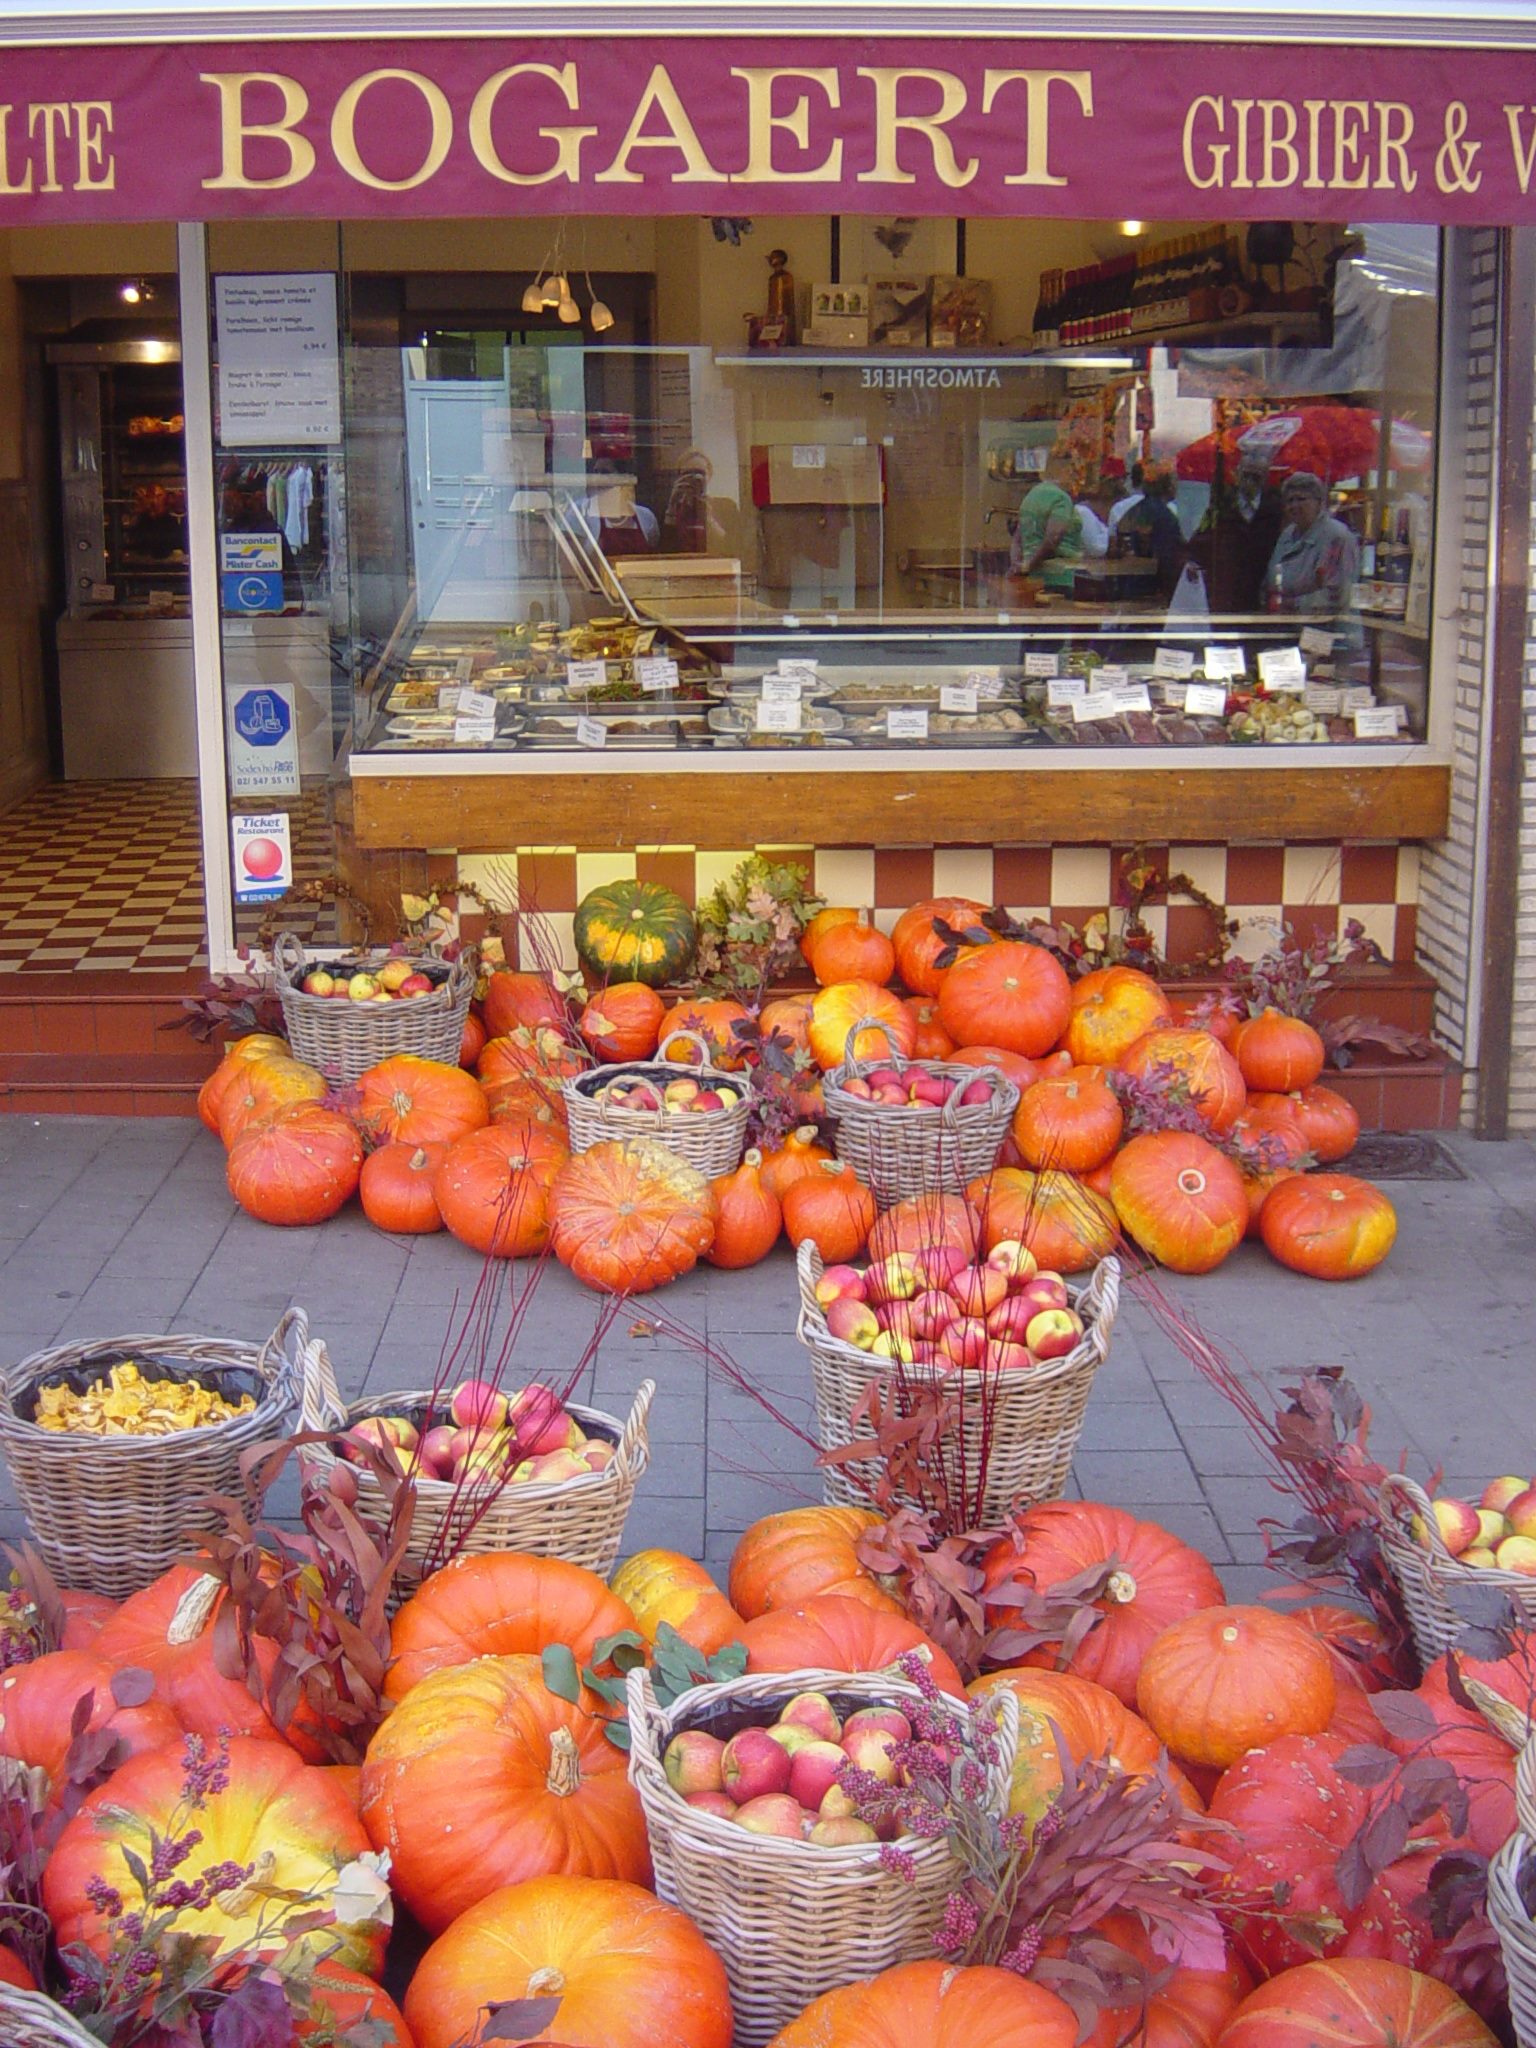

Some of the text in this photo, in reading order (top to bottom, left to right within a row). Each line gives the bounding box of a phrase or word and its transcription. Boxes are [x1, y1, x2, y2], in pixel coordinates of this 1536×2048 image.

[200, 62, 1094, 191] BOGAERT
[1182, 95, 1418, 193] GIBIER
[1435, 101, 1482, 194] &
[225, 536, 277, 545] Bancontact
[225, 560, 279, 569] Mister Cash
[242, 817, 281, 828] Ticket
